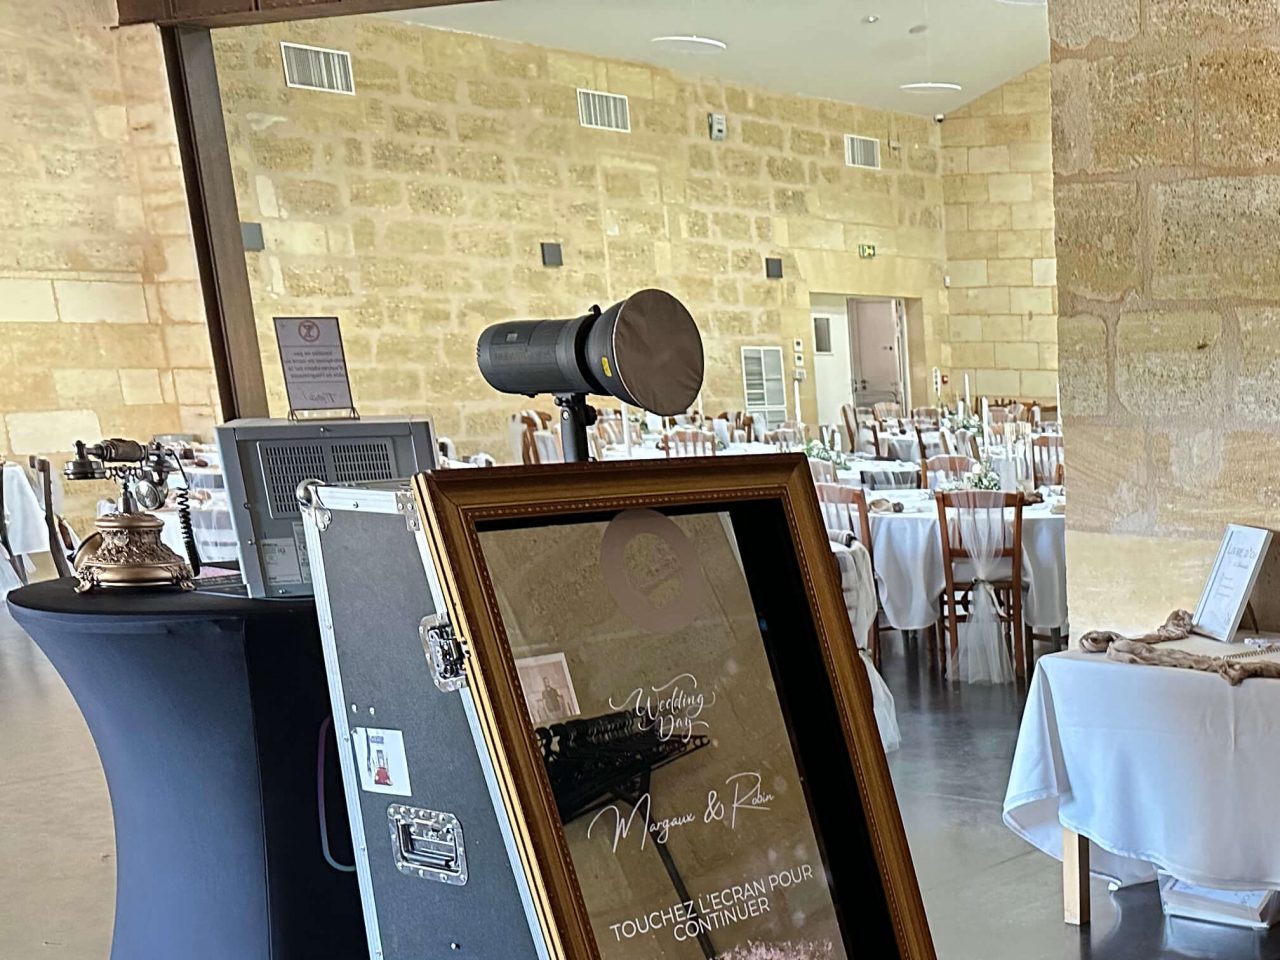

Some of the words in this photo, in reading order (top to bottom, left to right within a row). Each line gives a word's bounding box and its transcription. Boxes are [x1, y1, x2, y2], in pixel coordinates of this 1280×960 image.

[609, 673, 716, 720] Wedding
[638, 715, 710, 743] Day
[587, 793, 696, 854] Margaux
[704, 790, 725, 824] &
[726, 772, 775, 830] Robin
[609, 900, 698, 942] TOUCHEZ
[698, 879, 766, 914] L'ECRAN
[768, 863, 814, 891] POUR
[673, 897, 771, 942] CONTINUER
